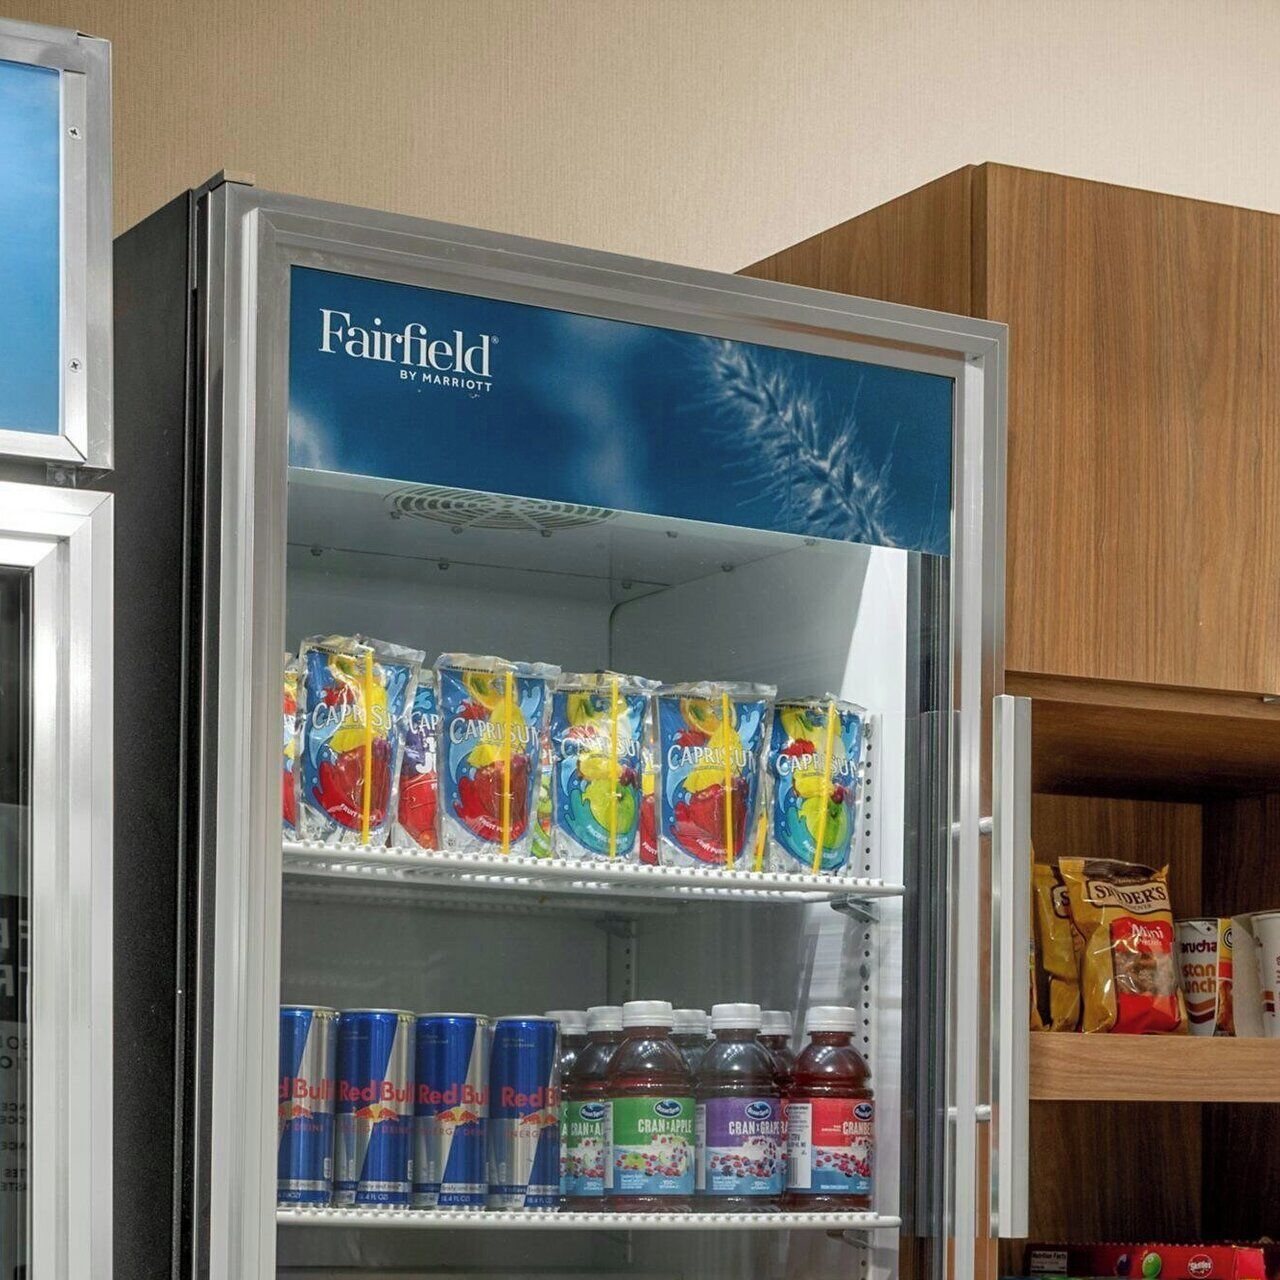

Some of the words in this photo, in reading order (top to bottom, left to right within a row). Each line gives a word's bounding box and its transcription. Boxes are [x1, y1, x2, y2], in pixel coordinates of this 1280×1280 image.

[319, 308, 492, 378] Fairfield
[399, 369, 416, 381] BY
[422, 372, 492, 392] MARRIOTT
[450, 718, 501, 744] CAPRI
[668, 745, 718, 770] CAPRI
[1132, 924, 1163, 937] Mini
[340, 1080, 377, 1102] Red
[380, 1081, 413, 1101] Bull
[420, 1083, 457, 1105] Red
[502, 1084, 543, 1107] Red
[638, 1119, 665, 1133] CRAN
[671, 1120, 692, 1134] APPLE
[729, 1122, 755, 1135] CRAN
